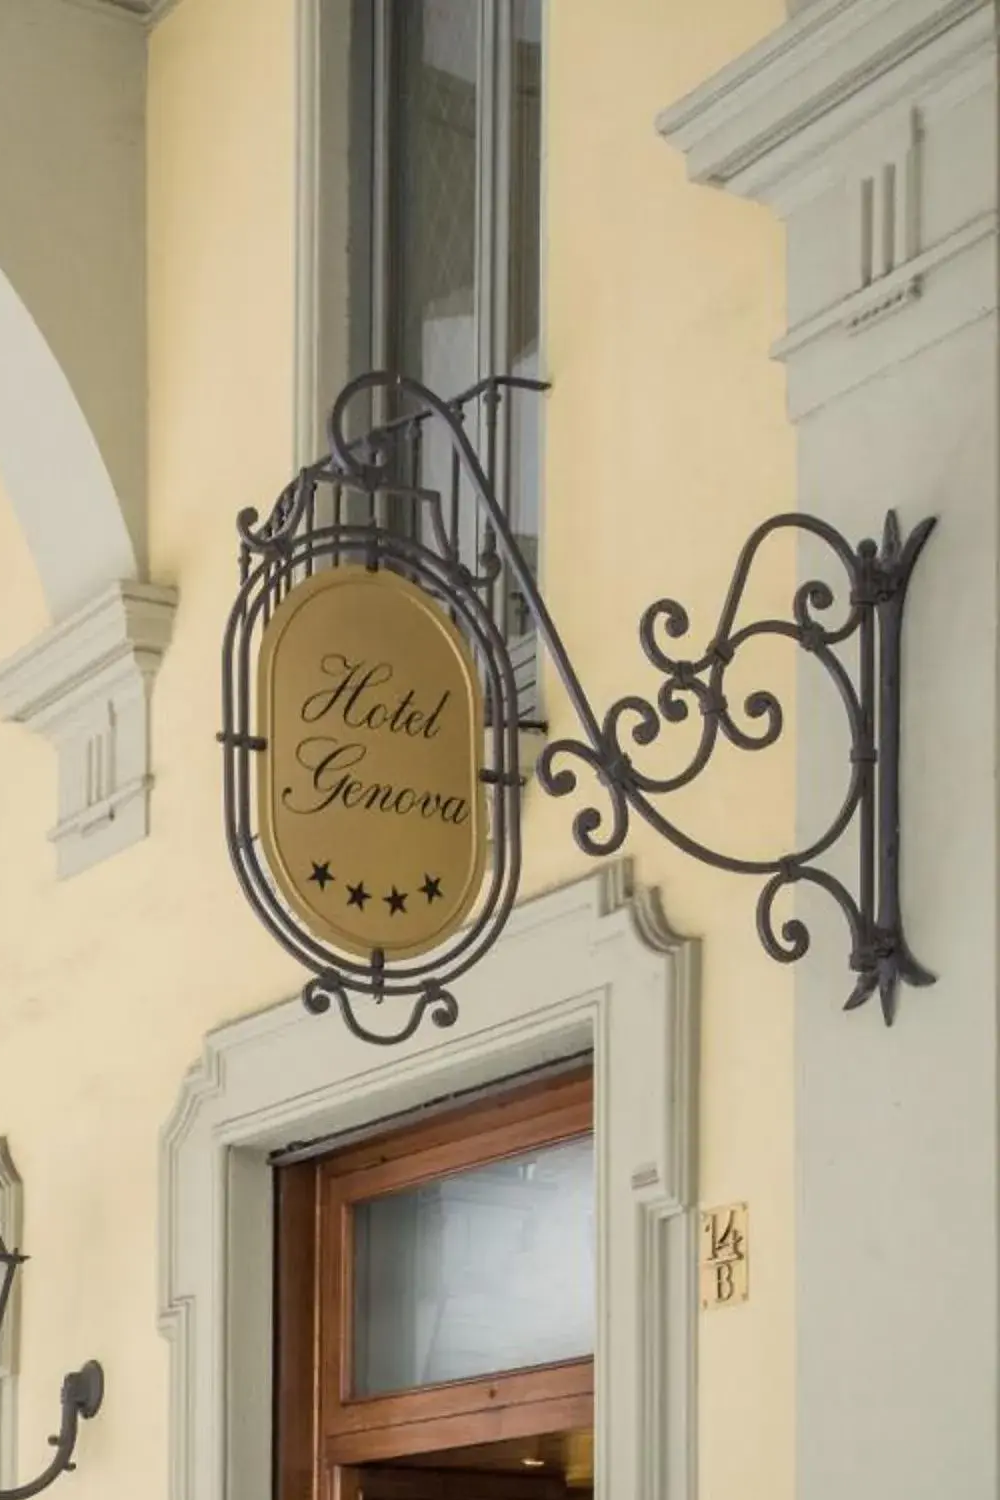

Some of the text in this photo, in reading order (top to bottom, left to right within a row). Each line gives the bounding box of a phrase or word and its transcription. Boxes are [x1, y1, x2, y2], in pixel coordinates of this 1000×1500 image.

[301, 653, 450, 739] Hotel
[281, 736, 469, 825] Genova
[705, 1210, 744, 1260] 14
[716, 1262, 734, 1303] B
